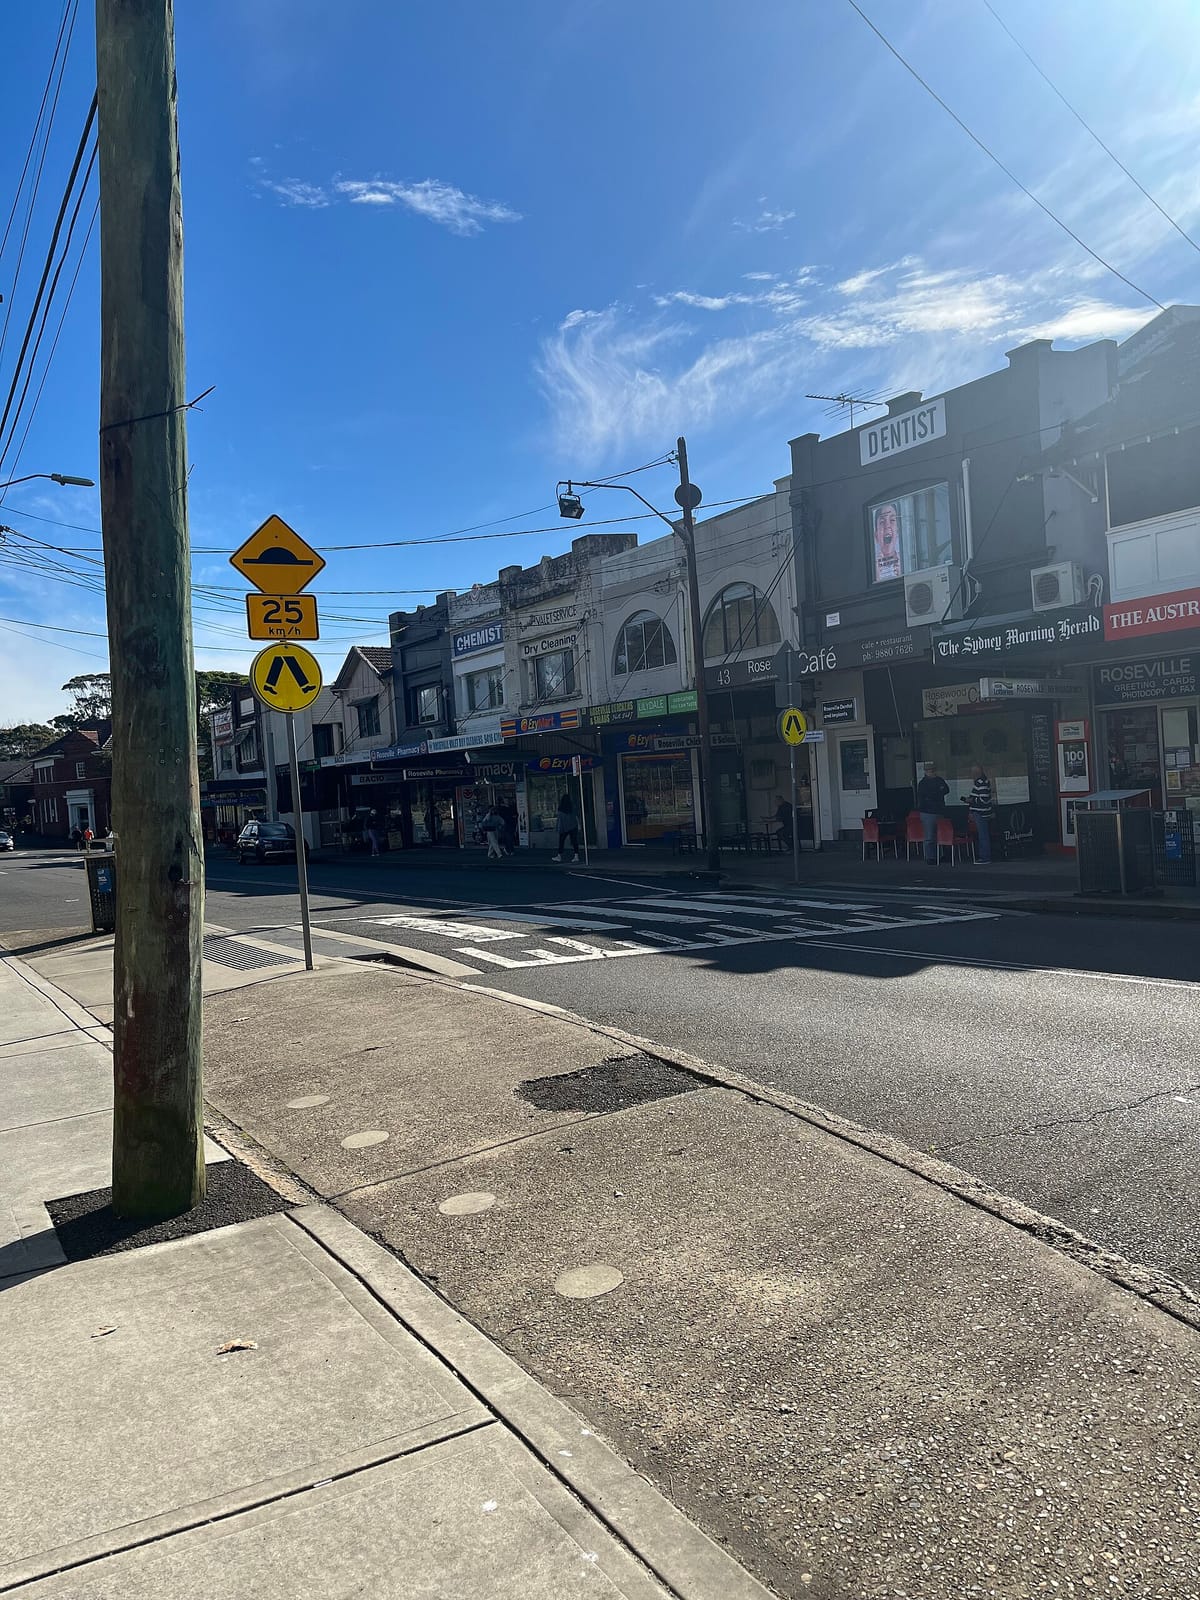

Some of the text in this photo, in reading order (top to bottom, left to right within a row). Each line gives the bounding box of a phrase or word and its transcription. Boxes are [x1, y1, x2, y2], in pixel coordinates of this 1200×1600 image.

[868, 406, 937, 457] DENTIST
[262, 599, 304, 624] 25
[553, 605, 578, 622] SERVICE
[1110, 600, 1200, 629] THE AUSTR
[268, 626, 301, 637] km/h
[456, 624, 502, 650] CHEMIST
[937, 614, 1100, 657] The Sydney Morning Herald
[524, 635, 577, 655] Dry Cleaning
[880, 634, 913, 646] restaurant
[895, 643, 914, 655] 7626
[799, 645, 837, 674] Café
[747, 660, 771, 674] Rose
[1100, 658, 1191, 683] ROSEVILLE
[717, 669, 731, 686] 43
[1113, 676, 1196, 692] GREETING CARDS
[926, 687, 967, 701] Rosewood
[1121, 687, 1167, 699] PHOTOCOPY
[1180, 685, 1196, 693] FAX
[639, 699, 665, 711] LILYDALE
[528, 717, 555, 732] EzyMart
[657, 739, 685, 748] Roseville
[686, 737, 701, 746] Chick
[376, 750, 395, 759] Roseville
[397, 747, 420, 757] Pharmacy
[1065, 751, 1084, 762] 100
[551, 757, 593, 769] Ezyart
[359, 776, 385, 784] BACIO
